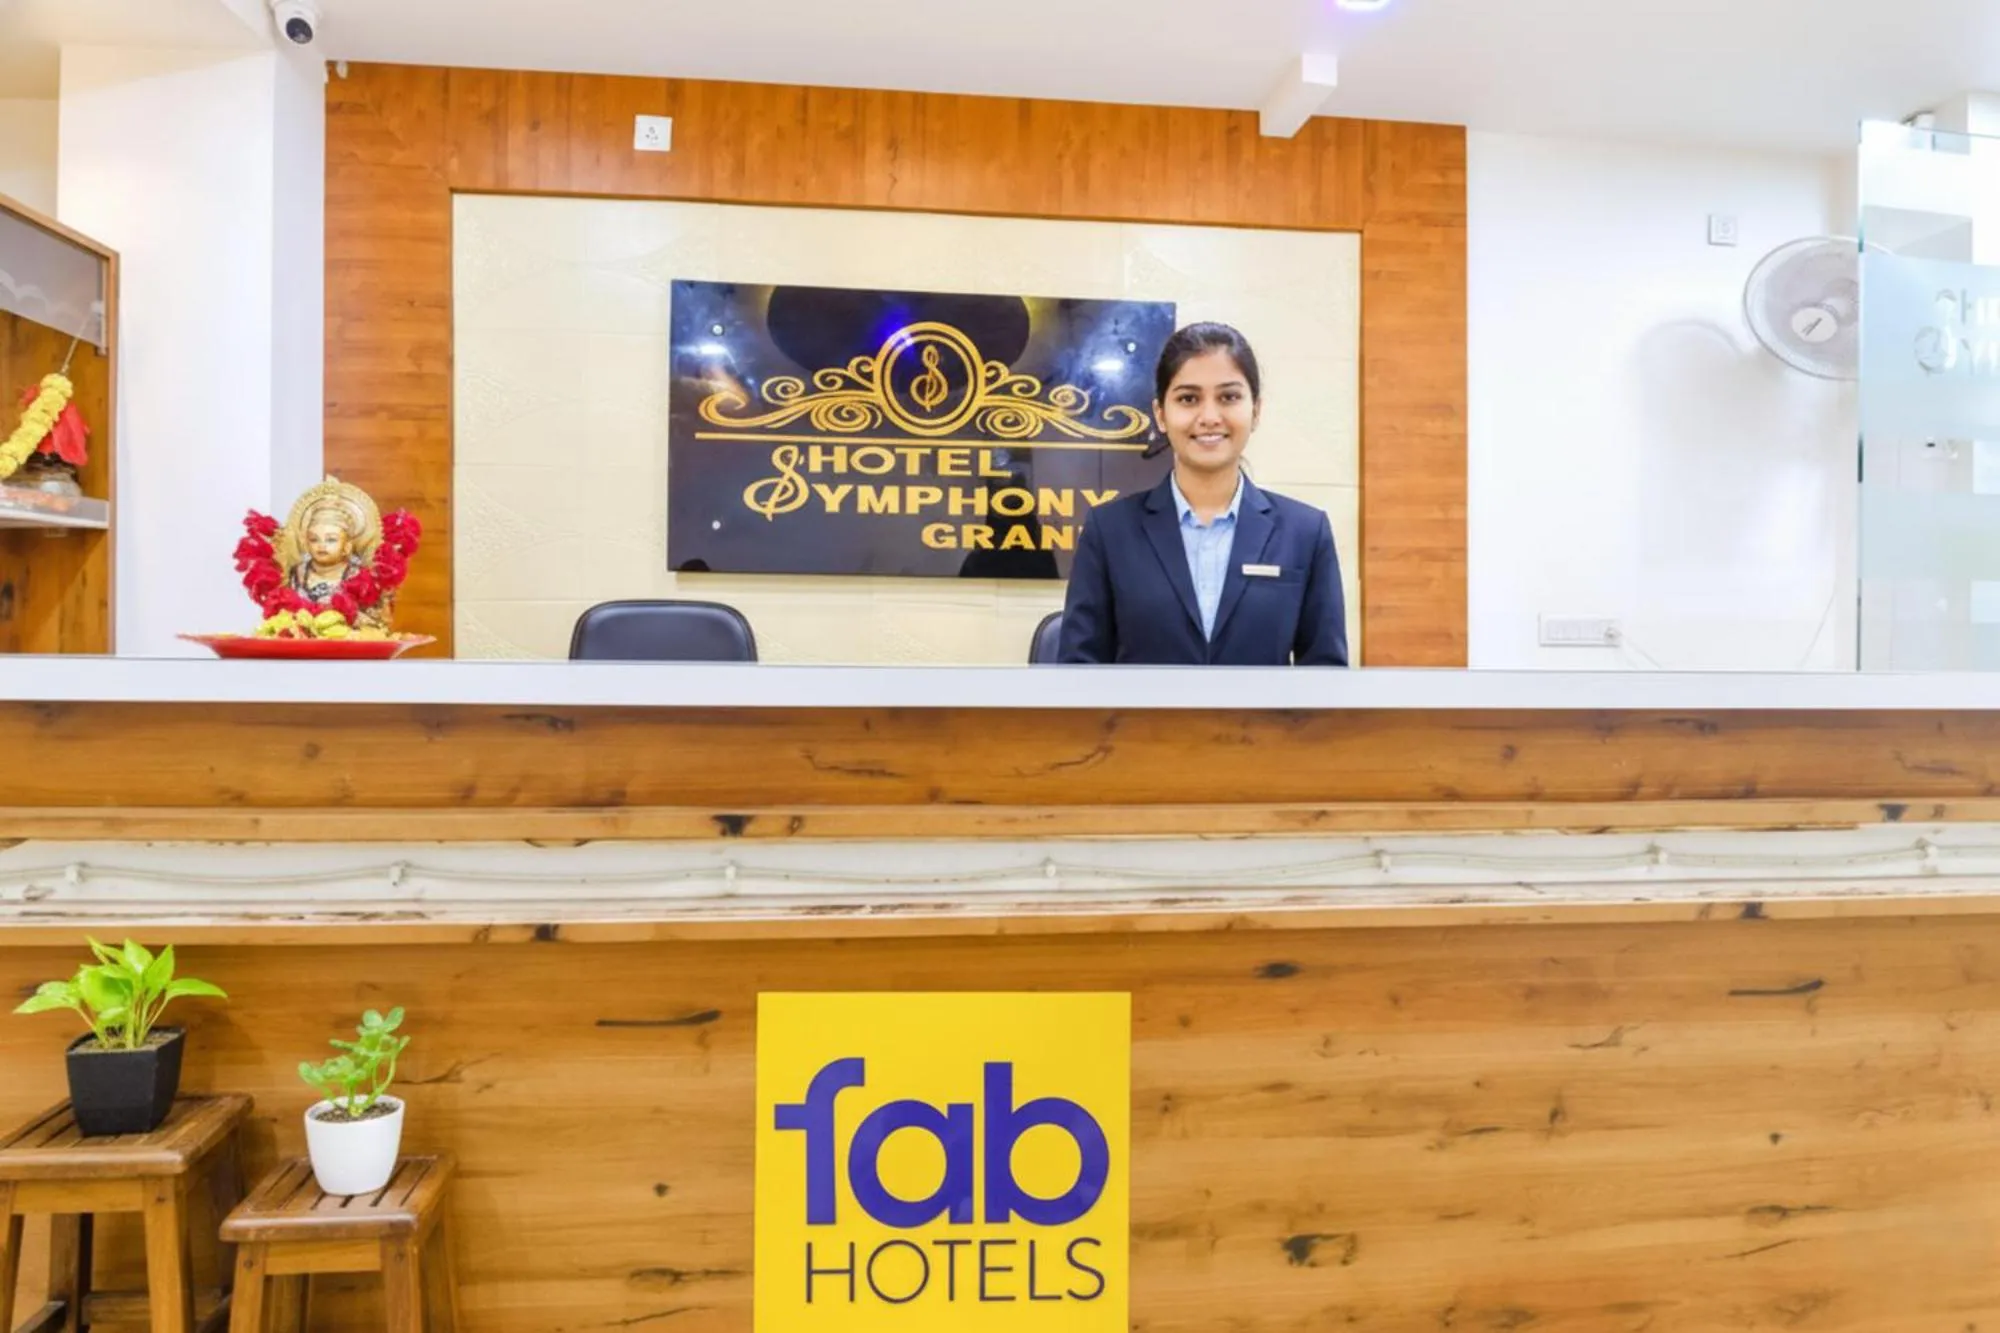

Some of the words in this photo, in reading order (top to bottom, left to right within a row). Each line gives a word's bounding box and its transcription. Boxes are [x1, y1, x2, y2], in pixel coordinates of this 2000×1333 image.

[807, 446, 1012, 478] HOTEL
[921, 522, 1084, 551] GRAN
[774, 1057, 1110, 1228] fab
[806, 1237, 1105, 1303] HOTELS
